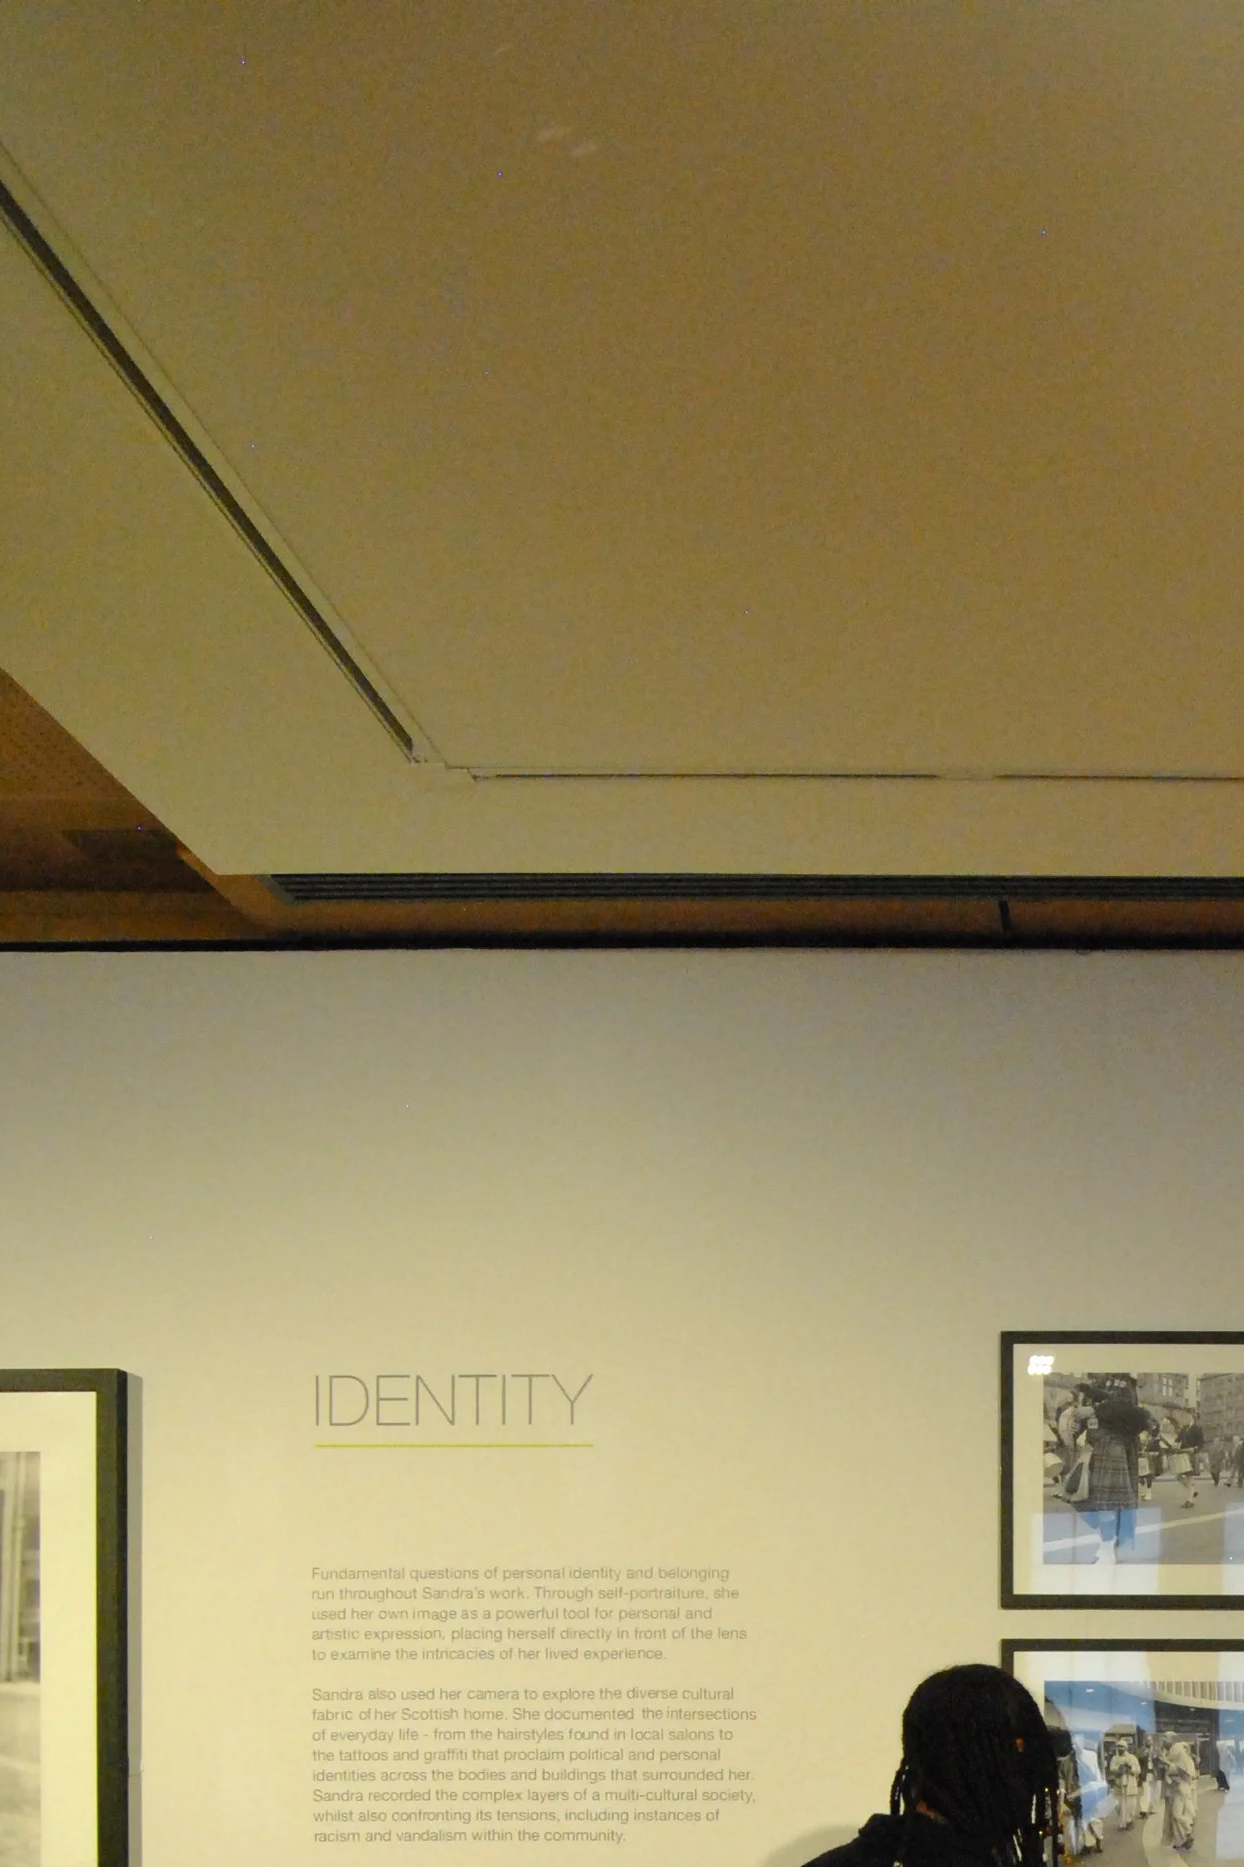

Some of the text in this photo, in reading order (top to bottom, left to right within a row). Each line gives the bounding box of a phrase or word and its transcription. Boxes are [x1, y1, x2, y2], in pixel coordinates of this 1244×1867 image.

[315, 1374, 594, 1426] IDENTITY
[312, 1567, 730, 1582] Fundamental questions personal identity and belonging
[312, 1586, 739, 1603] run throughout Sandra's work. Through self-portraiture, she
[312, 1607, 712, 1622] used her image powerful tool personal and
[312, 1627, 747, 1643] artistic expression, placing herself directly front the lens
[330, 1648, 666, 1662] examine the intricacies her lived experience.
[312, 1687, 734, 1703] Sandra also used her camera explore the diverse cultural
[312, 1707, 757, 1721] fabric her Scottish home. She documented the intersections
[330, 1728, 714, 1744] everyday life from the hairstyles found local salons
[312, 1748, 721, 1764] the tattoos and graffiti that proclaim political and personal
[312, 1768, 754, 1784] identities across the bodies and buildings that surrounded her.
[313, 1789, 755, 1804] Sandra recorded the complex layers multi-cultural society,
[313, 1809, 701, 1825] whilst also confronting tensions, including instances
[314, 1829, 625, 1844] racism and vandalism within the community.
